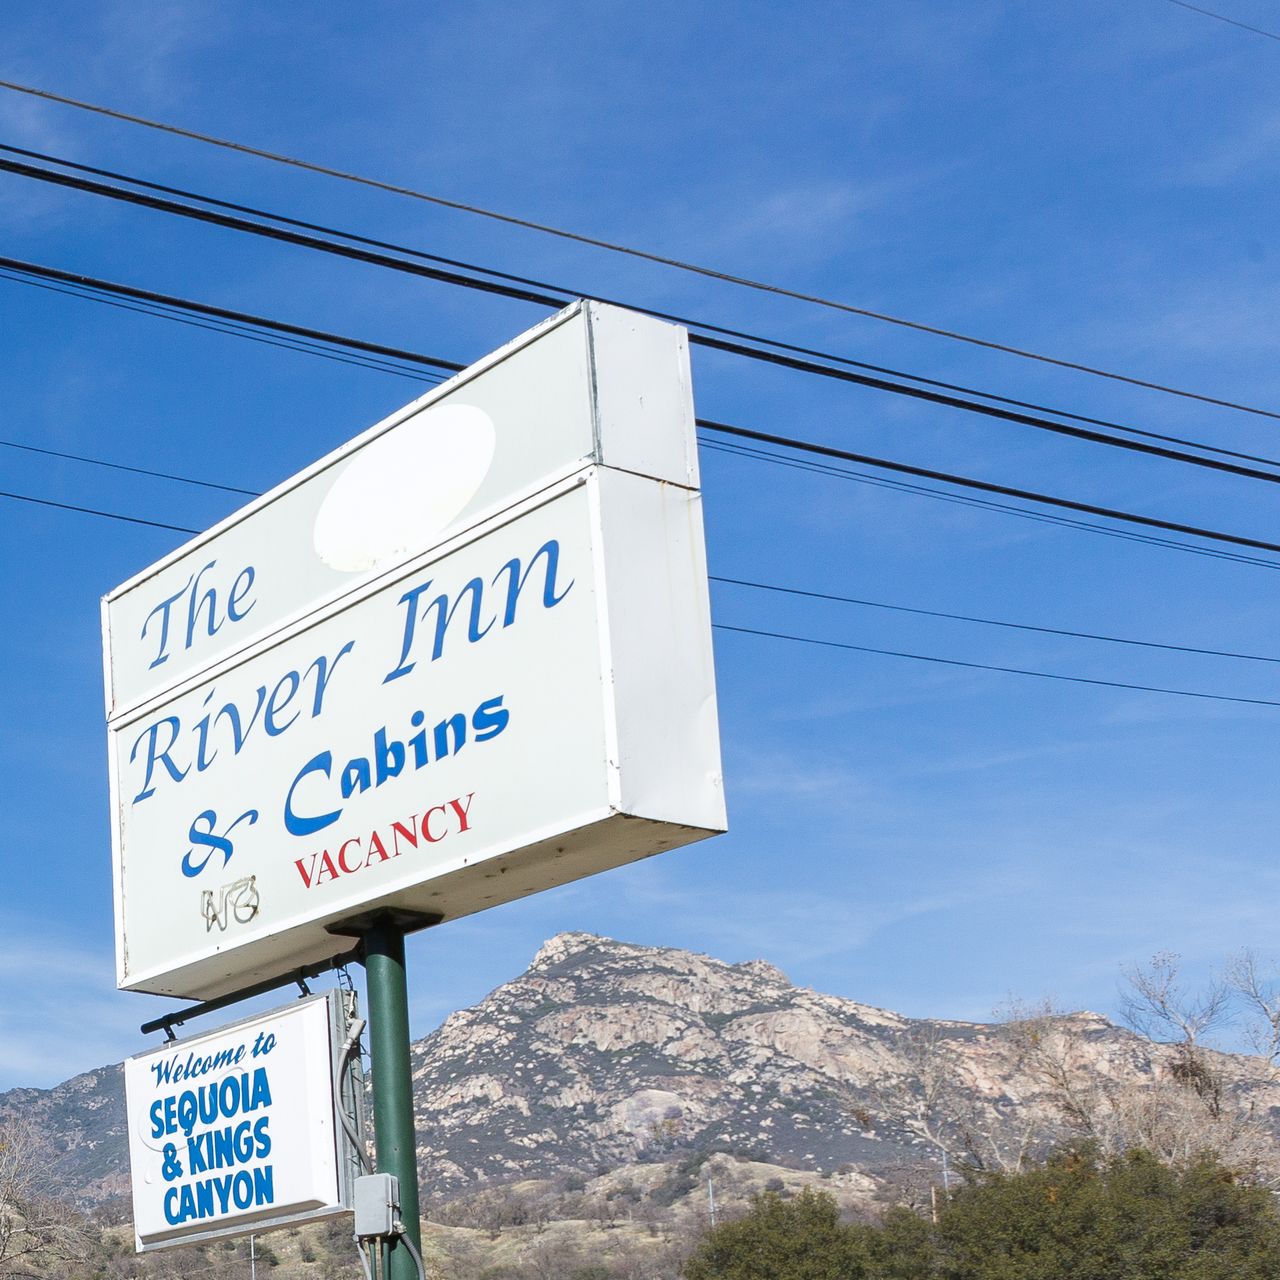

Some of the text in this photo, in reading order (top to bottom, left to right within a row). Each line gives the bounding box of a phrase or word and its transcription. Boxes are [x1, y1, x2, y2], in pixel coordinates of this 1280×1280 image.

[141, 560, 257, 671] The
[130, 539, 576, 805] River Inn
[181, 694, 510, 878] & Cabins
[293, 793, 476, 890] VACANCY
[151, 1031, 277, 1088] Welcome to
[149, 1067, 273, 1139] SEQUOIA
[161, 1116, 272, 1182] & KINGS
[163, 1165, 274, 1226] CANYON
